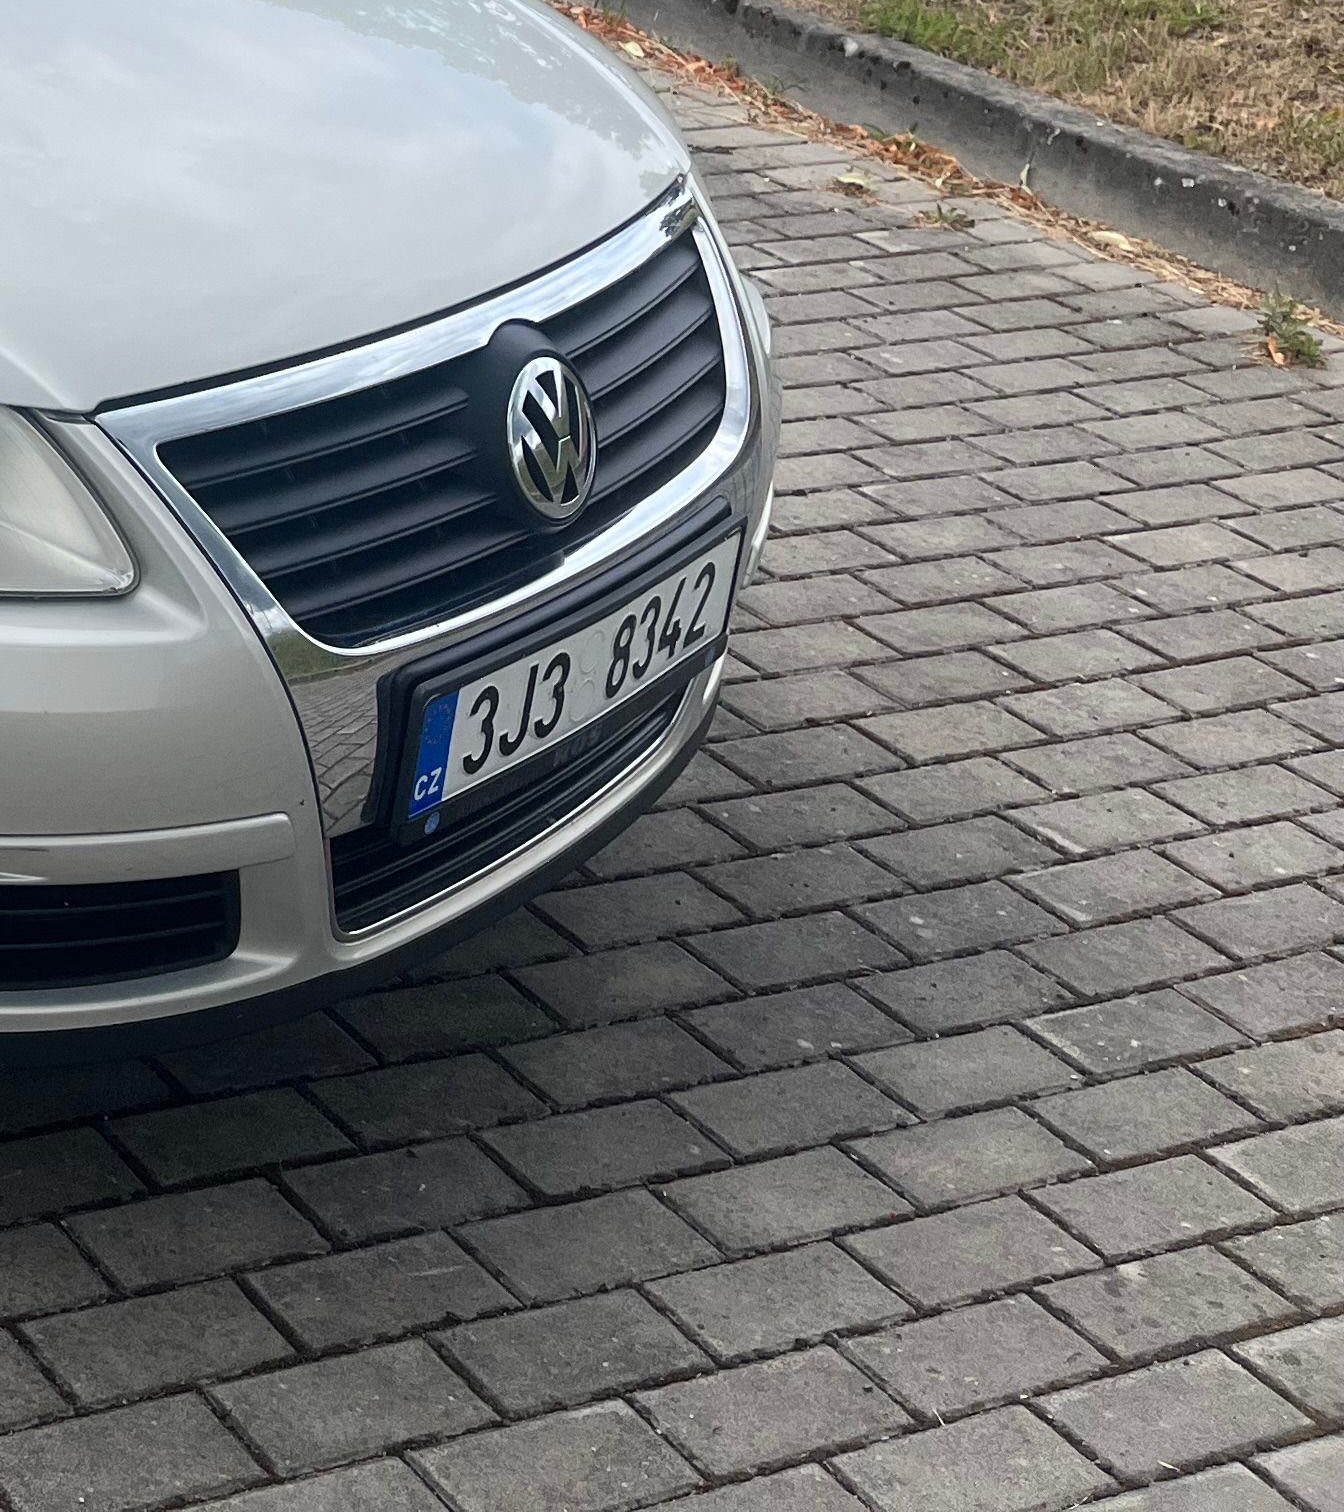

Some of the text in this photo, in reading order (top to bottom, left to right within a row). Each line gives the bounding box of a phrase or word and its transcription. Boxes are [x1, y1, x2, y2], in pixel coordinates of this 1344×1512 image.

[507, 356, 598, 521] VW
[463, 562, 716, 775] 3J3 8342
[413, 767, 443, 801] CZ
